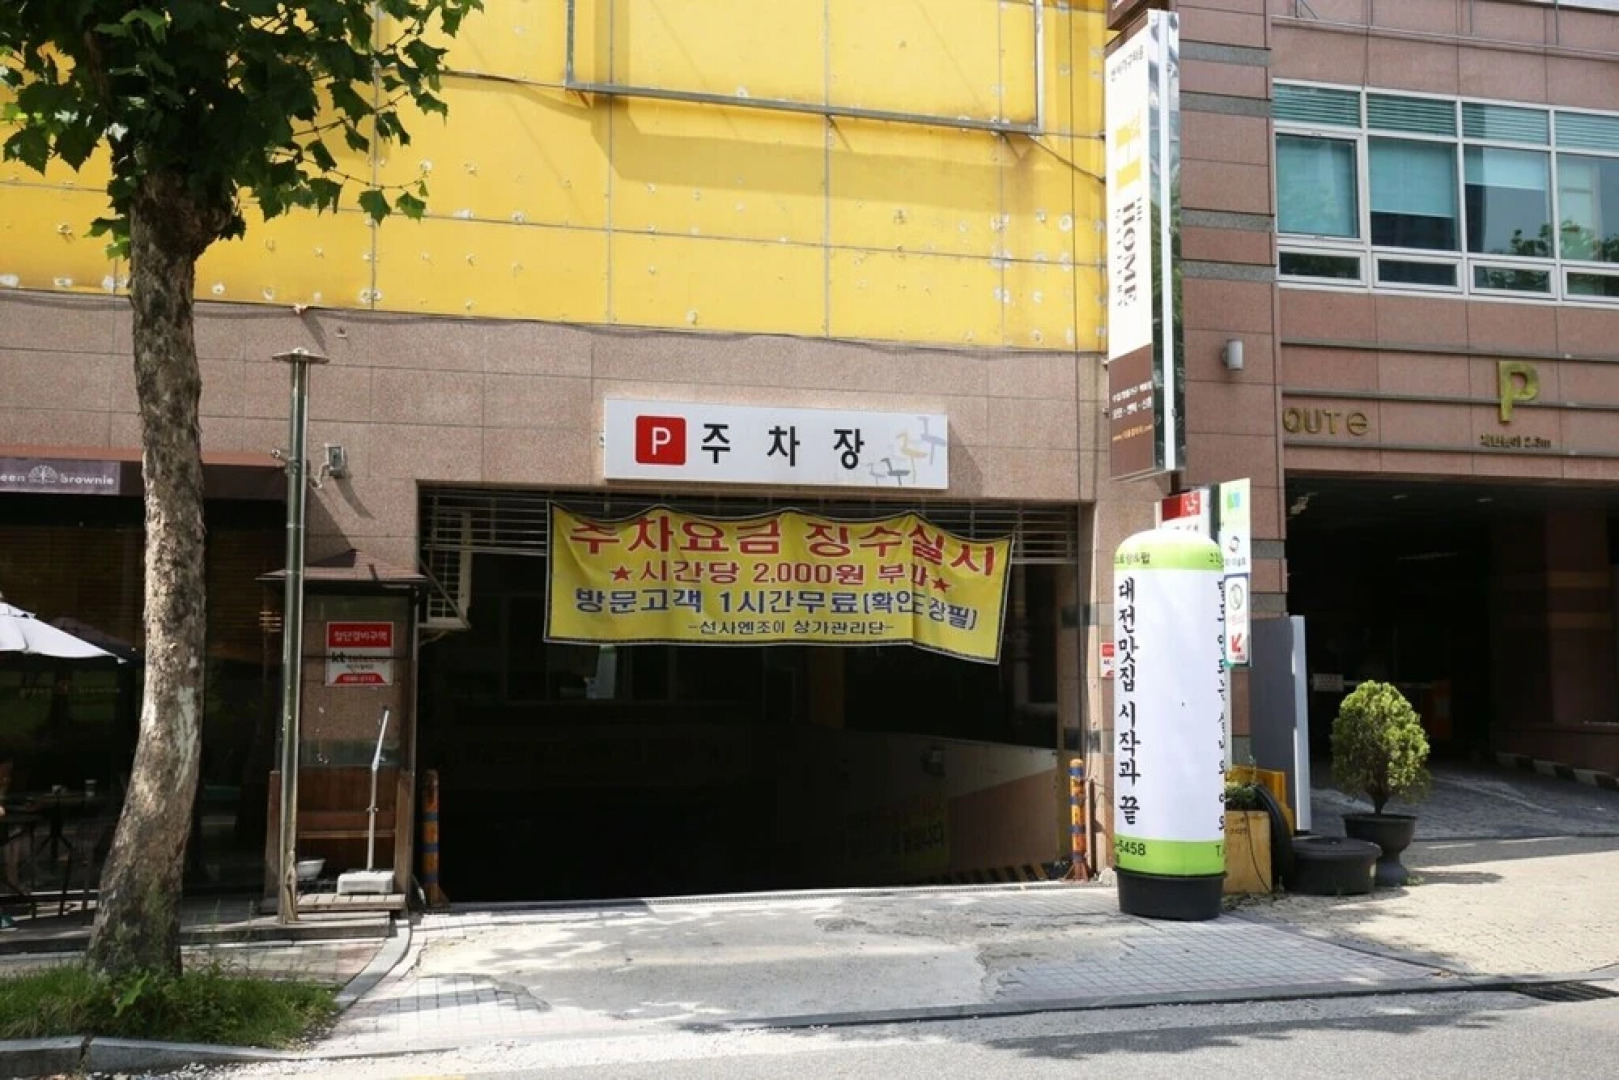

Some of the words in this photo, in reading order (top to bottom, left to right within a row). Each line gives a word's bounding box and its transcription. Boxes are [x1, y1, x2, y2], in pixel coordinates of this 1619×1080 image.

[1496, 360, 1541, 424] P
[651, 427, 672, 456] P
[701, 422, 866, 470] 주차장
[60, 473, 114, 485] brownie
[570, 516, 780, 555] 주차요금
[804, 521, 996, 577] 징수실시
[639, 560, 740, 585] 시간당
[575, 587, 702, 615] 방문고객
[1118, 577, 1140, 692] 대전맛집
[331, 651, 346, 664] kt
[1118, 701, 1141, 787] 시작과
[1118, 795, 1141, 825] 끝
